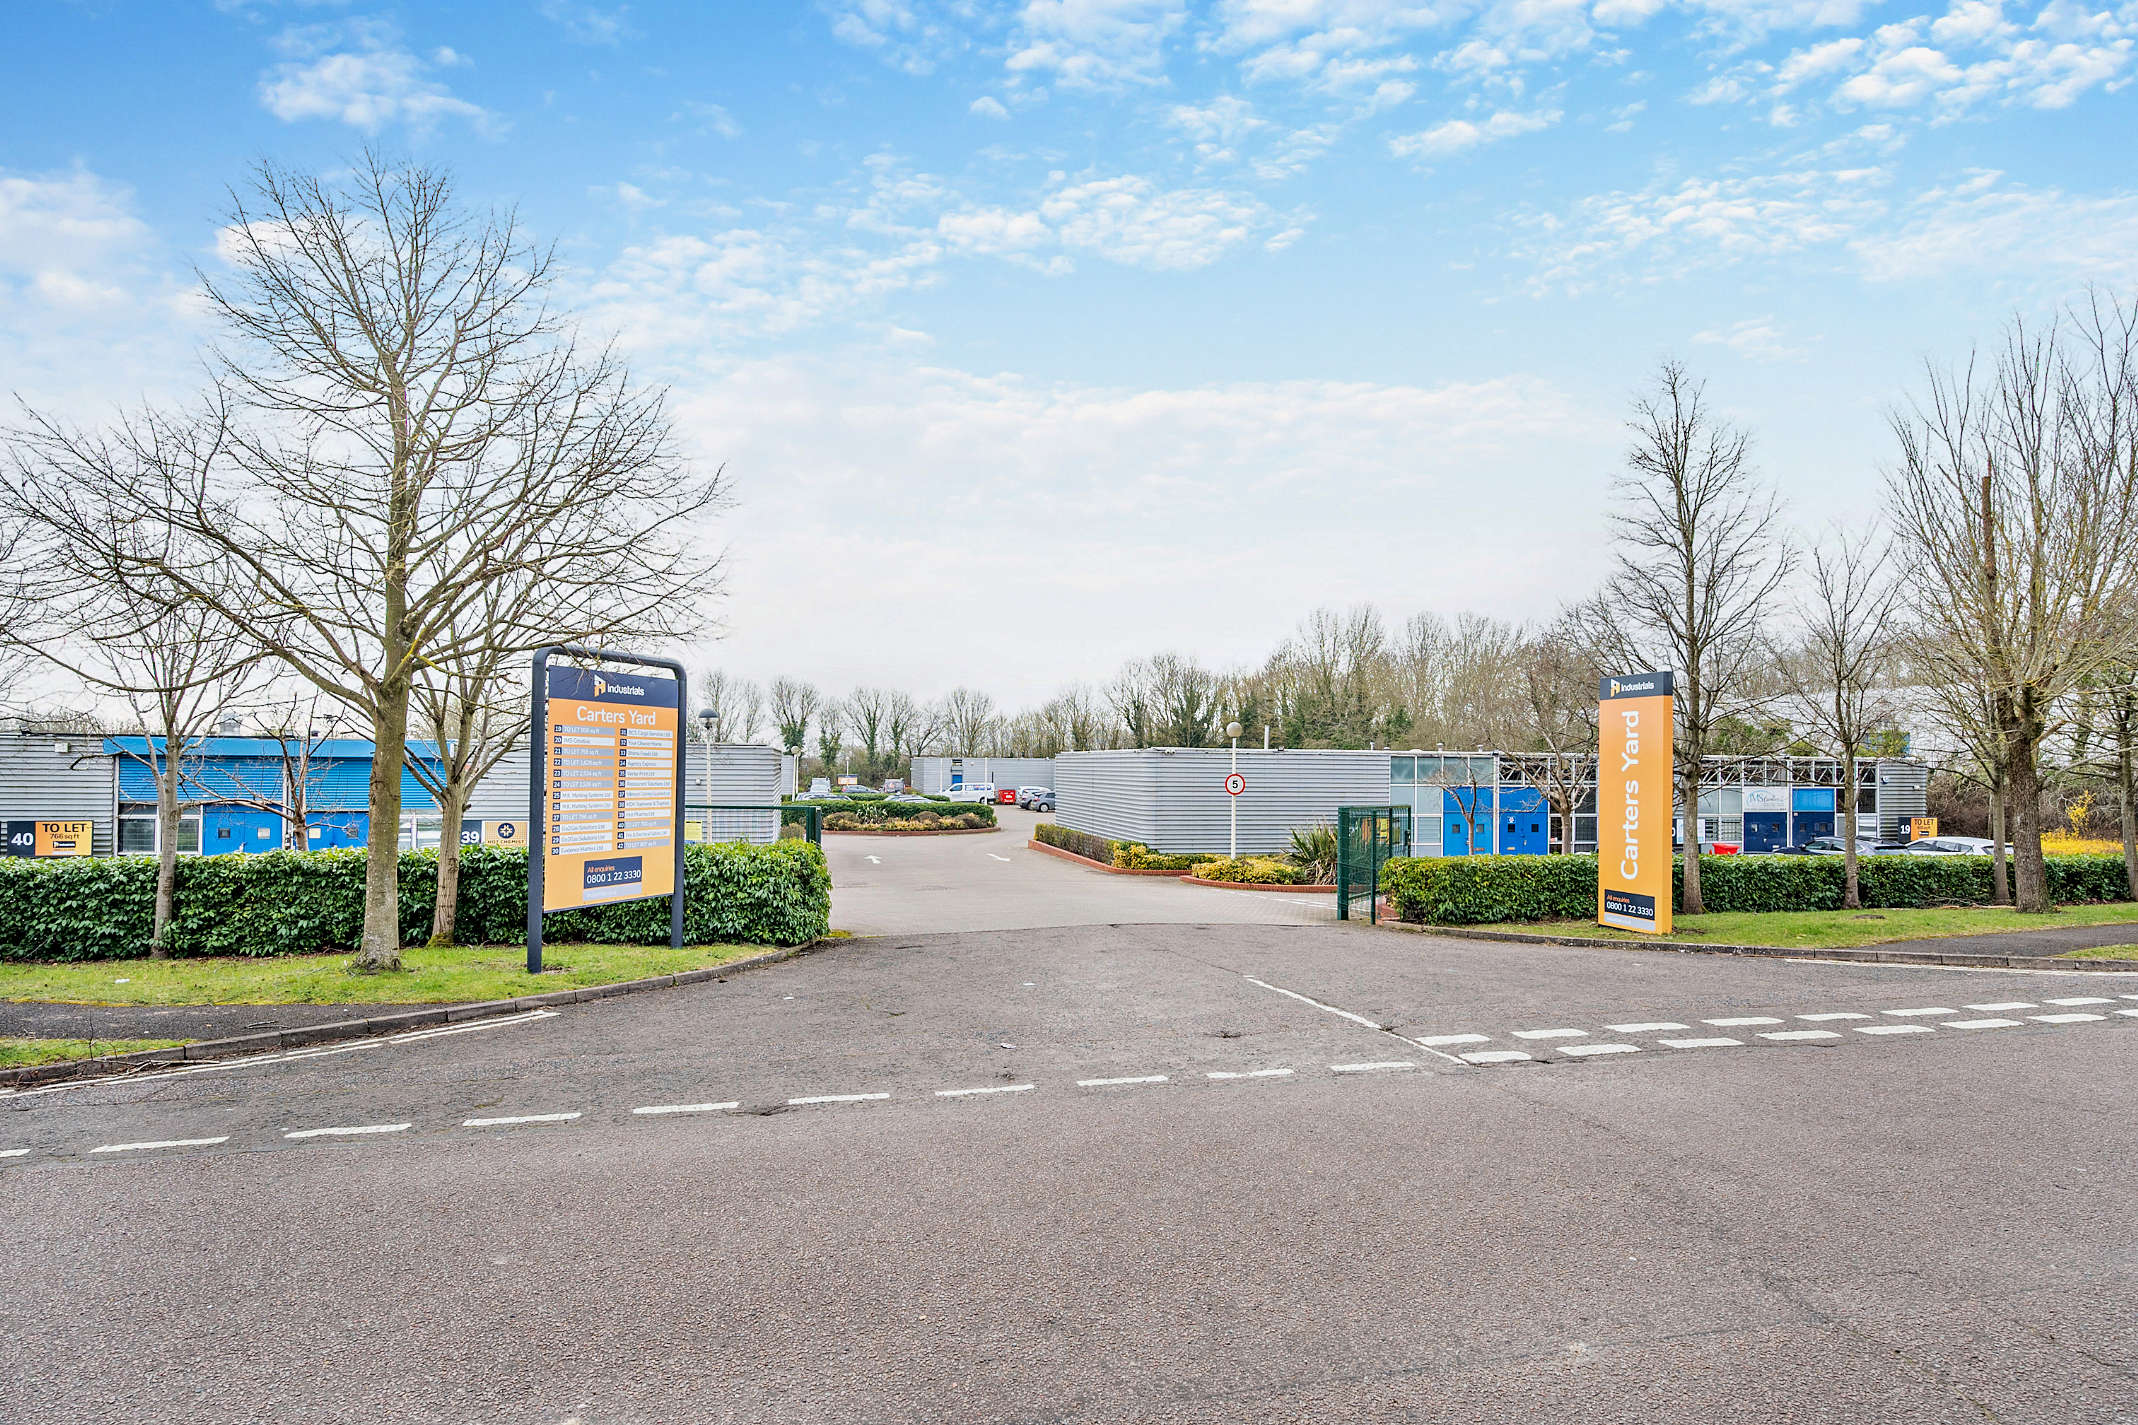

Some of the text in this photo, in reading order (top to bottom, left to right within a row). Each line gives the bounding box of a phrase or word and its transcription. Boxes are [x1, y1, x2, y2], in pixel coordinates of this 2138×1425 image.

[607, 684, 645, 696] Industrials
[1621, 681, 1655, 692] Industrials
[576, 705, 657, 726] Carters Yard
[1232, 780, 1238, 788] 5
[1620, 710, 1639, 880] Carters Yard
[42, 824, 87, 832] TO LET
[1900, 824, 1911, 834] 19
[11, 832, 34, 846] 40
[461, 830, 480, 844] 39
[586, 870, 641, 884] 0800 1 22 3330
[1606, 901, 1622, 911] 0800
[1628, 905, 1636, 914] 22
[1637, 906, 1654, 916] 3330
